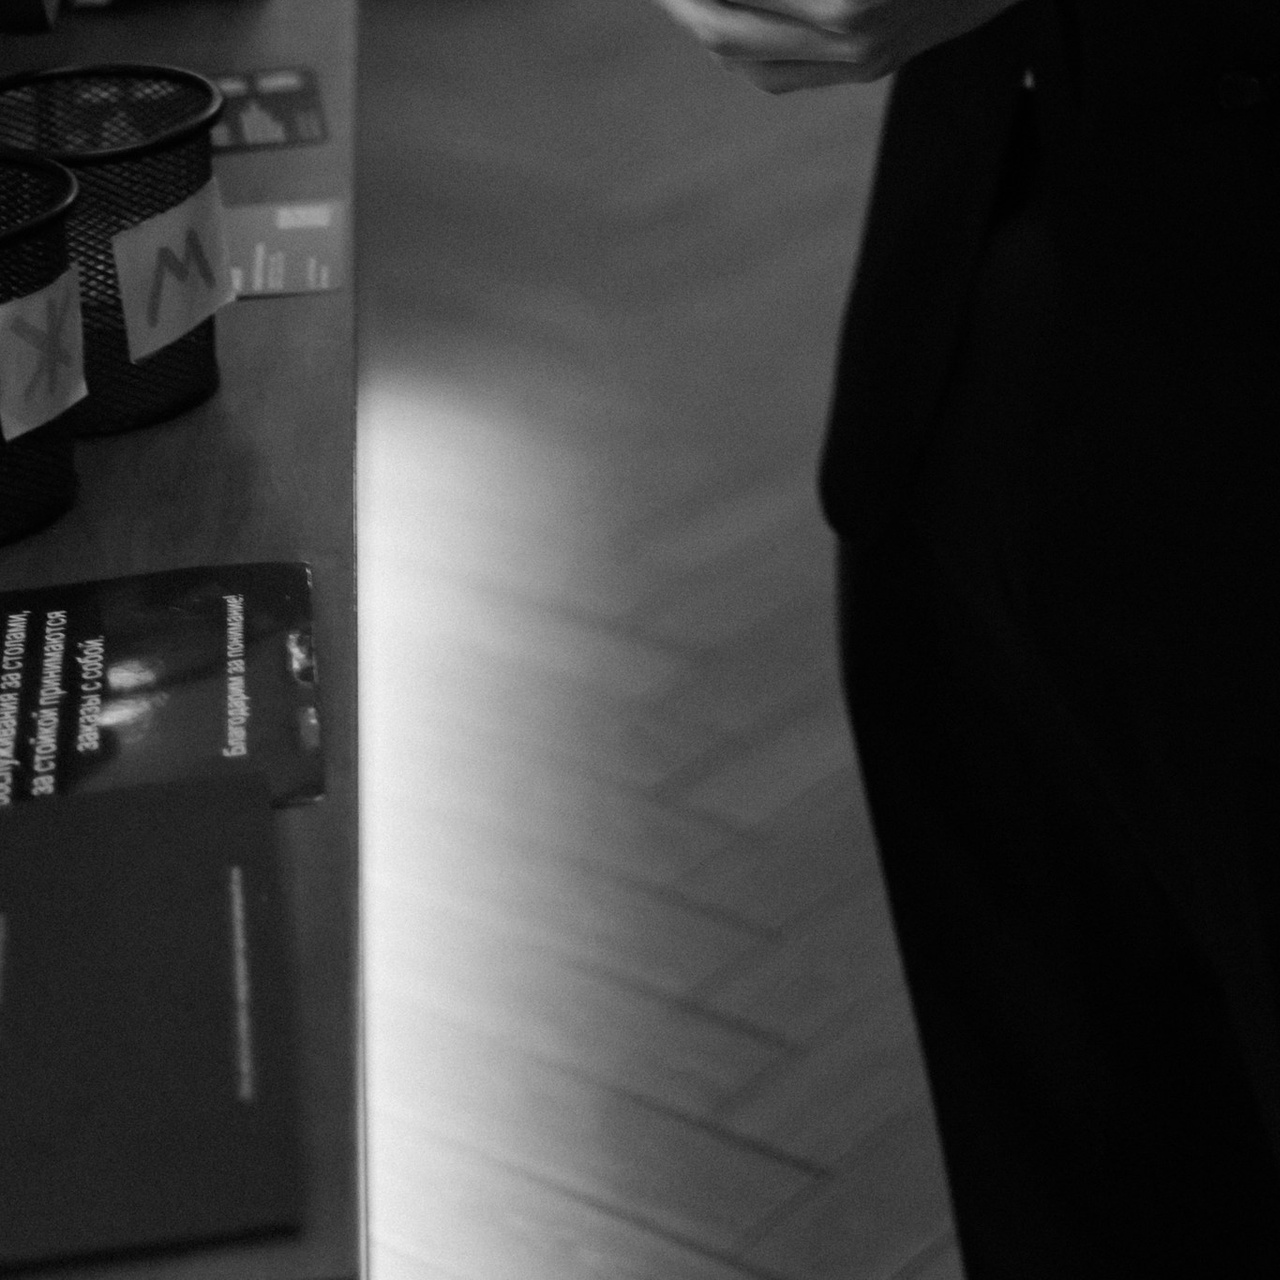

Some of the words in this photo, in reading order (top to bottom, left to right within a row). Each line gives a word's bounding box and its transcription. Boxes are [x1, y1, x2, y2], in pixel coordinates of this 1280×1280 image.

[2, 610, 31, 670] столами,
[222, 594, 245, 658] понимание!
[0, 672, 22, 689] за
[39, 610, 67, 706] принимаются
[75, 635, 105, 679] собой.
[81, 681, 102, 691] с
[227, 659, 246, 674] за
[29, 707, 60, 772] стойкой
[77, 694, 101, 752] заказы
[222, 676, 250, 757] Благодарим
[31, 775, 55, 795] за
